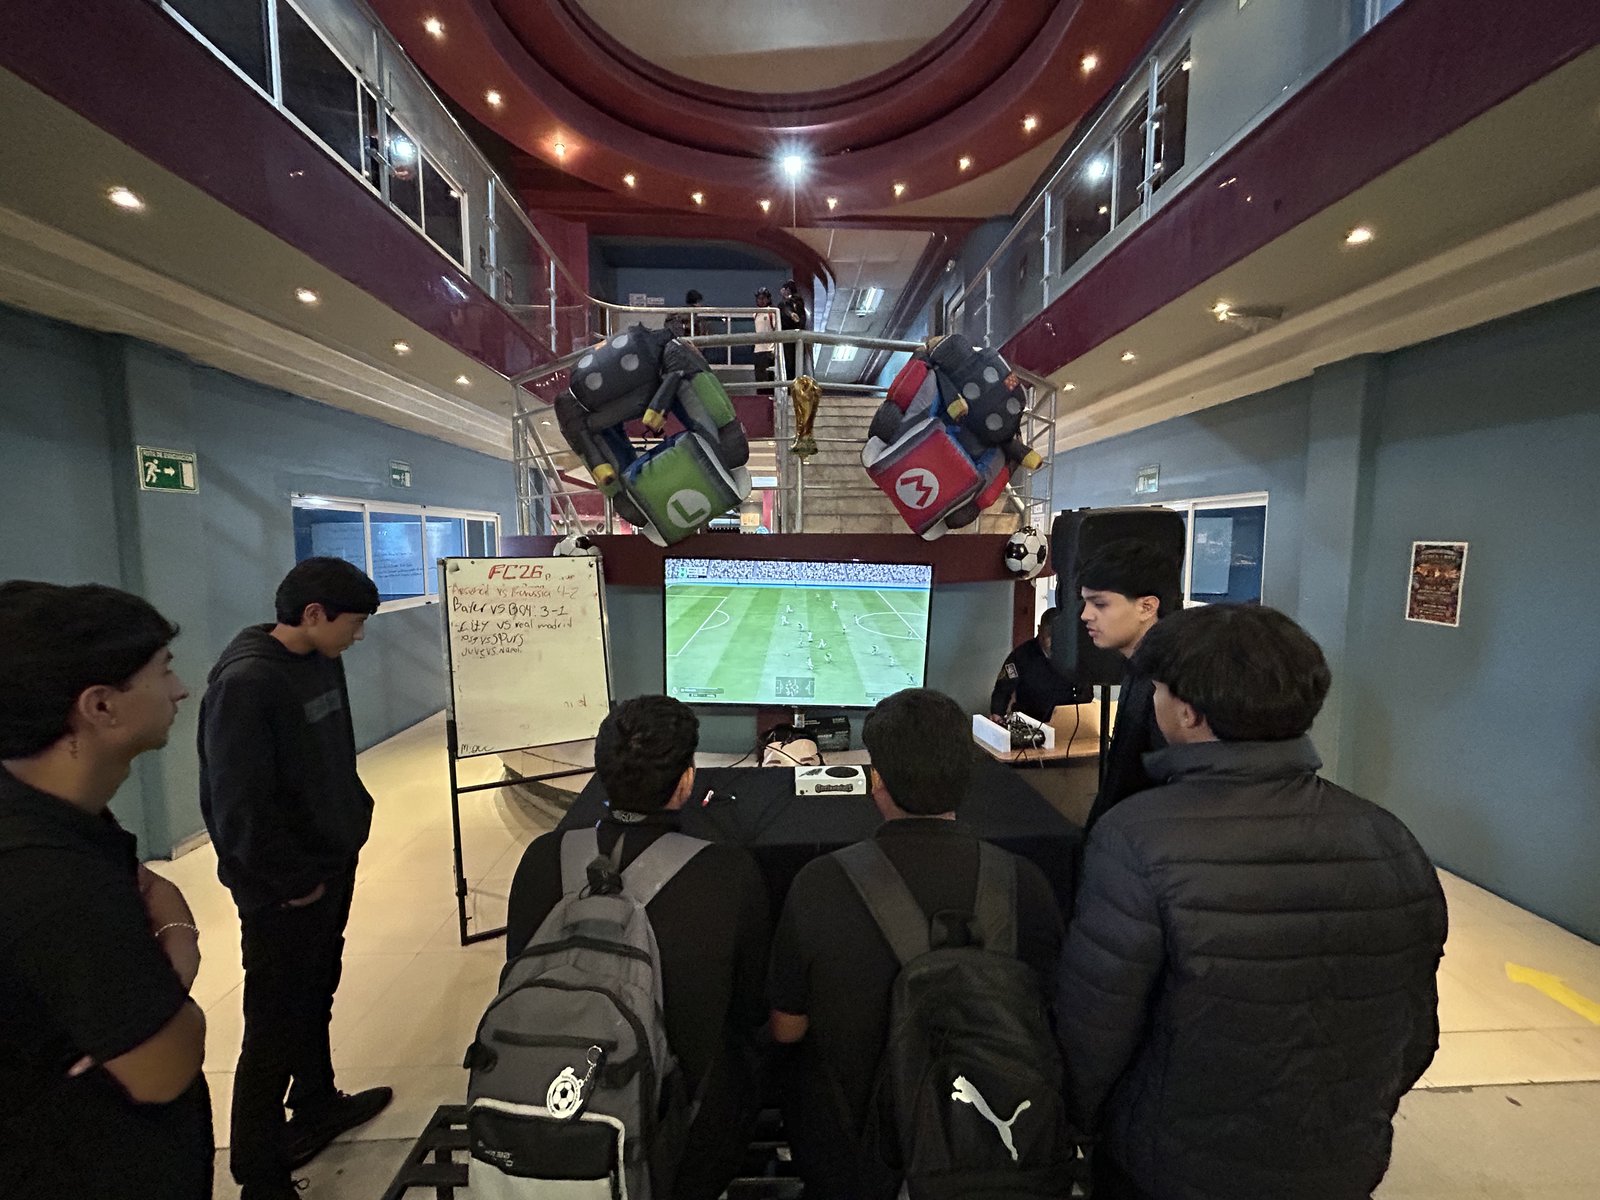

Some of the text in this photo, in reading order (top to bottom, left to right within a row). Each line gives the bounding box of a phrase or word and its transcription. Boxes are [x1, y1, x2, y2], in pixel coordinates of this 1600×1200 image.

[900, 475, 933, 508] M
[670, 499, 706, 523] L
[488, 564, 543, 580] FC26
